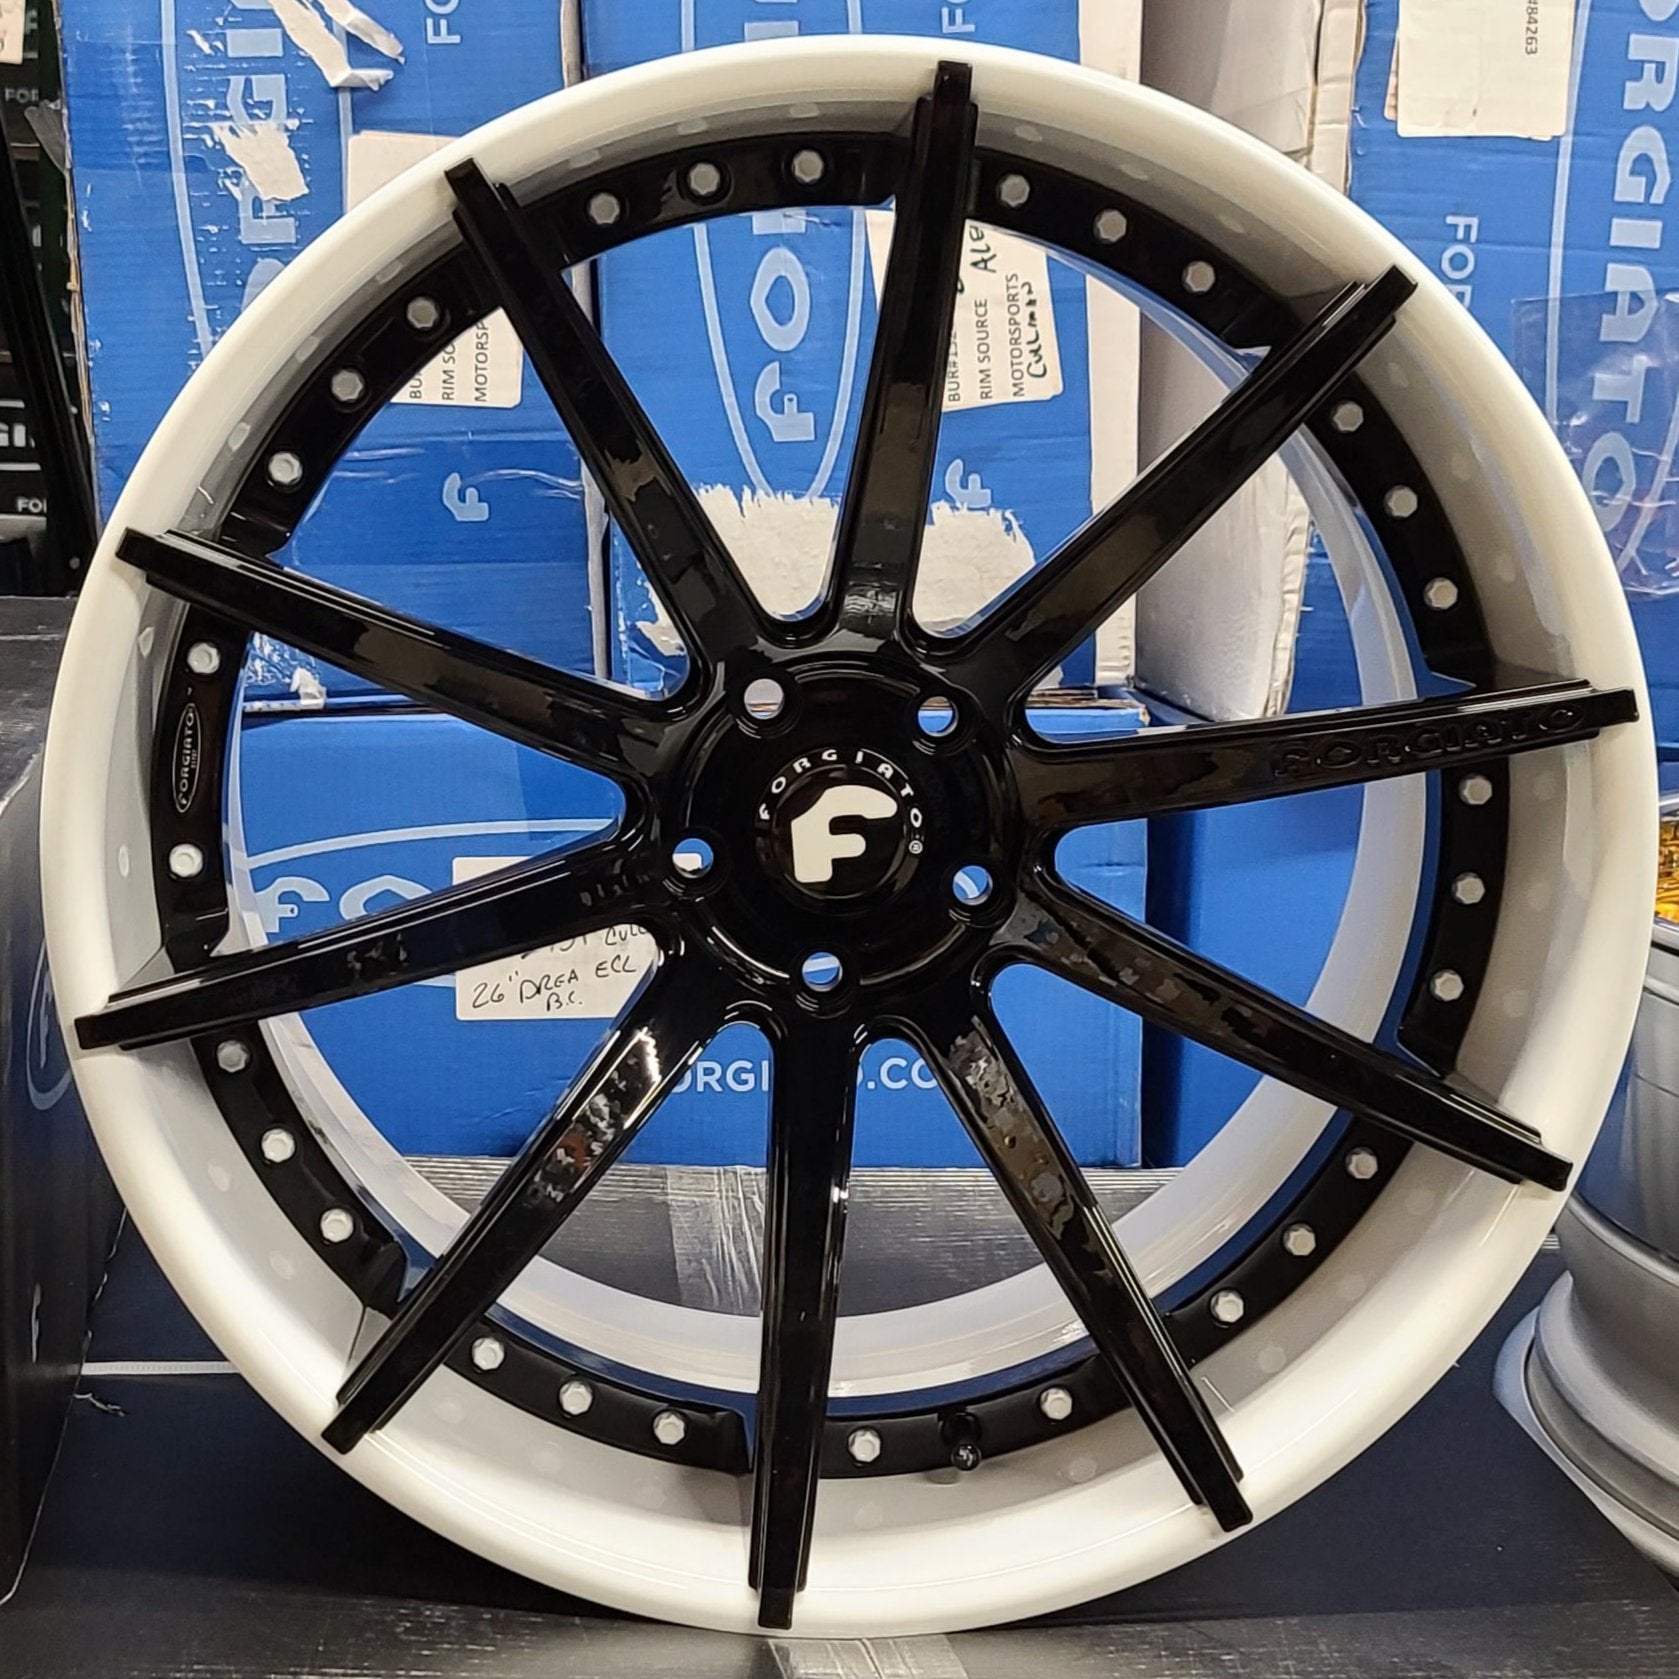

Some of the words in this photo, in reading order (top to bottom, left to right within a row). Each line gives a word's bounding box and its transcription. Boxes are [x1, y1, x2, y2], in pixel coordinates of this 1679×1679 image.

[974, 299, 991, 364] SOURCE
[1006, 273, 1025, 398] MOTORSPORTS
[441, 369, 456, 401] RIM
[979, 368, 993, 400] RIM
[178, 711, 195, 805] FORGIATO
[758, 749, 923, 828] FORGIATO
